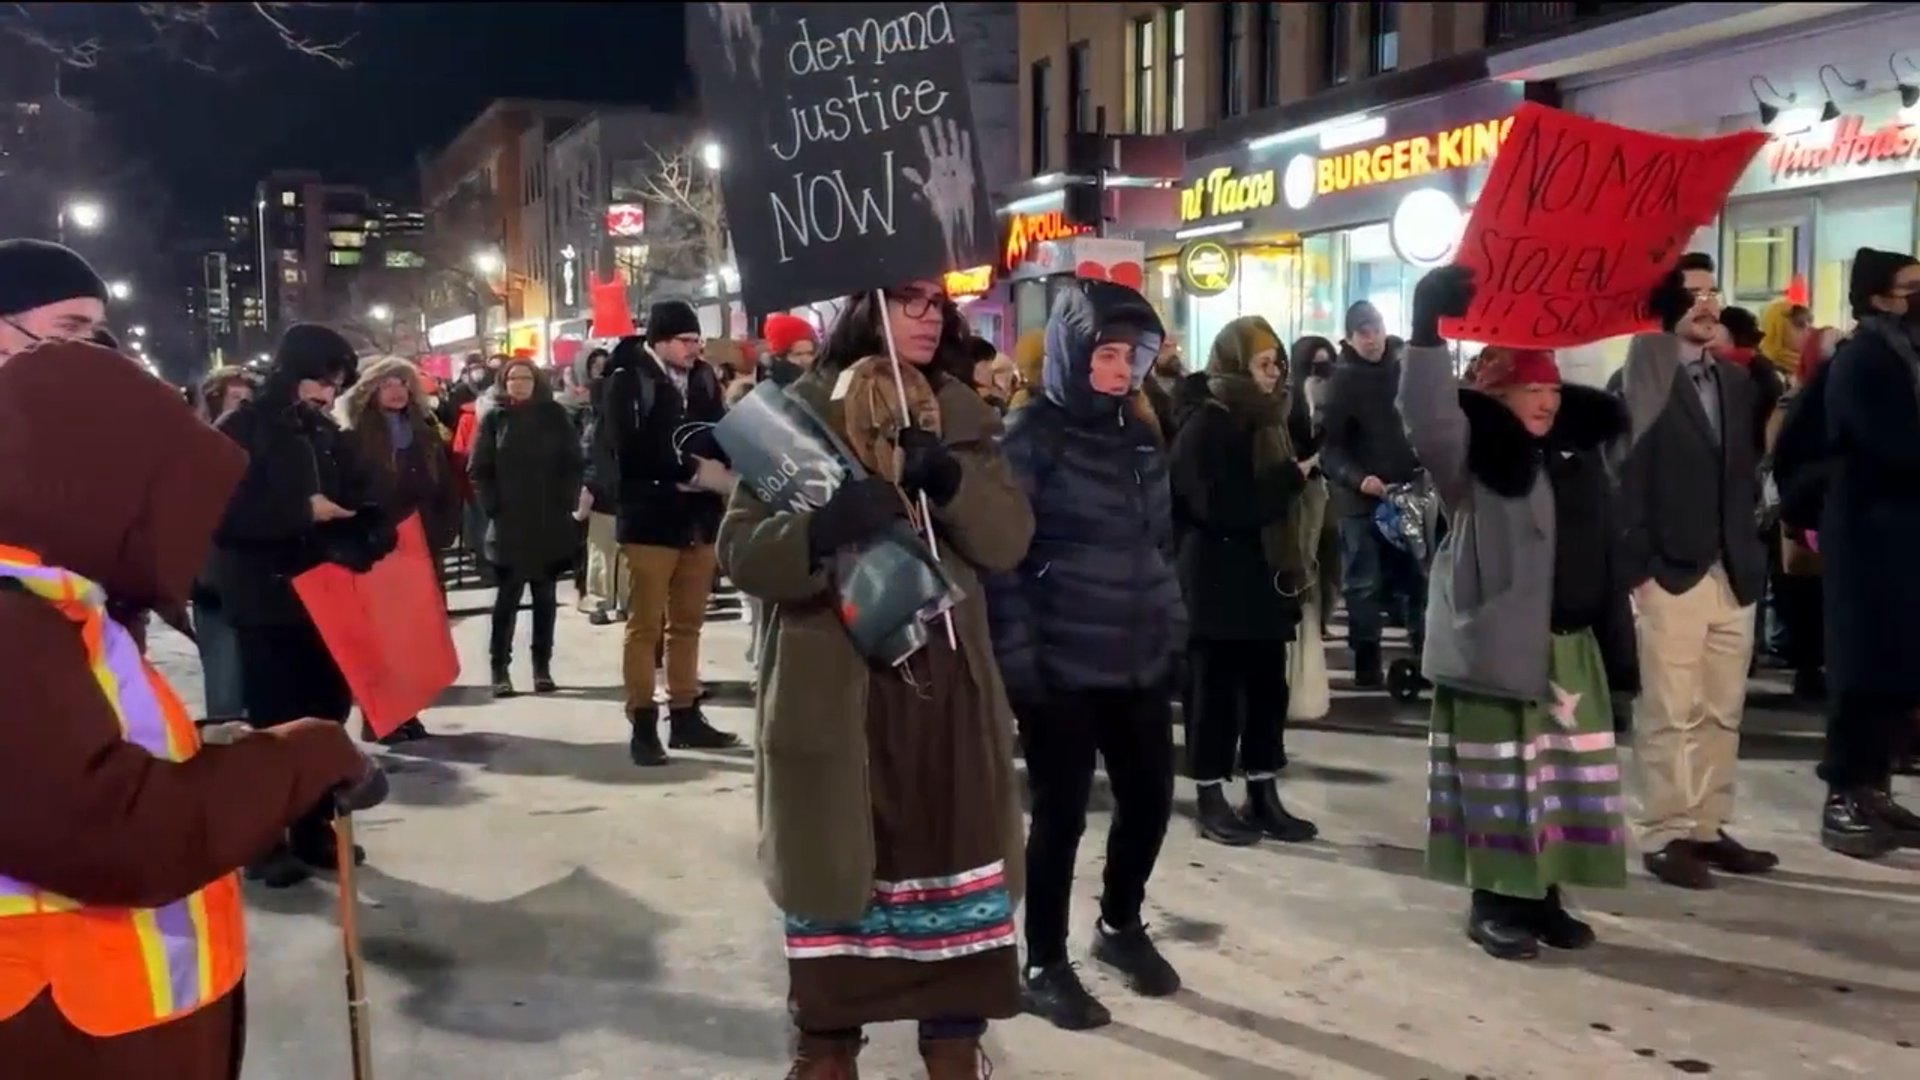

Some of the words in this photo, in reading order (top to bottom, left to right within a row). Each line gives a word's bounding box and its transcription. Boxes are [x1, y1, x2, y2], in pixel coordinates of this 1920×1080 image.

[788, 1, 955, 76] demand
[770, 75, 949, 161] justice
[1829, 113, 1920, 166] Horto
[1207, 166, 1274, 216] Tacos
[1317, 136, 1431, 195] BURGER
[1495, 115, 1590, 227] NO
[1585, 144, 1715, 221] MOR
[769, 150, 896, 264] NOW
[1027, 209, 1077, 242] POUL
[1480, 228, 1628, 296] STOLEN
